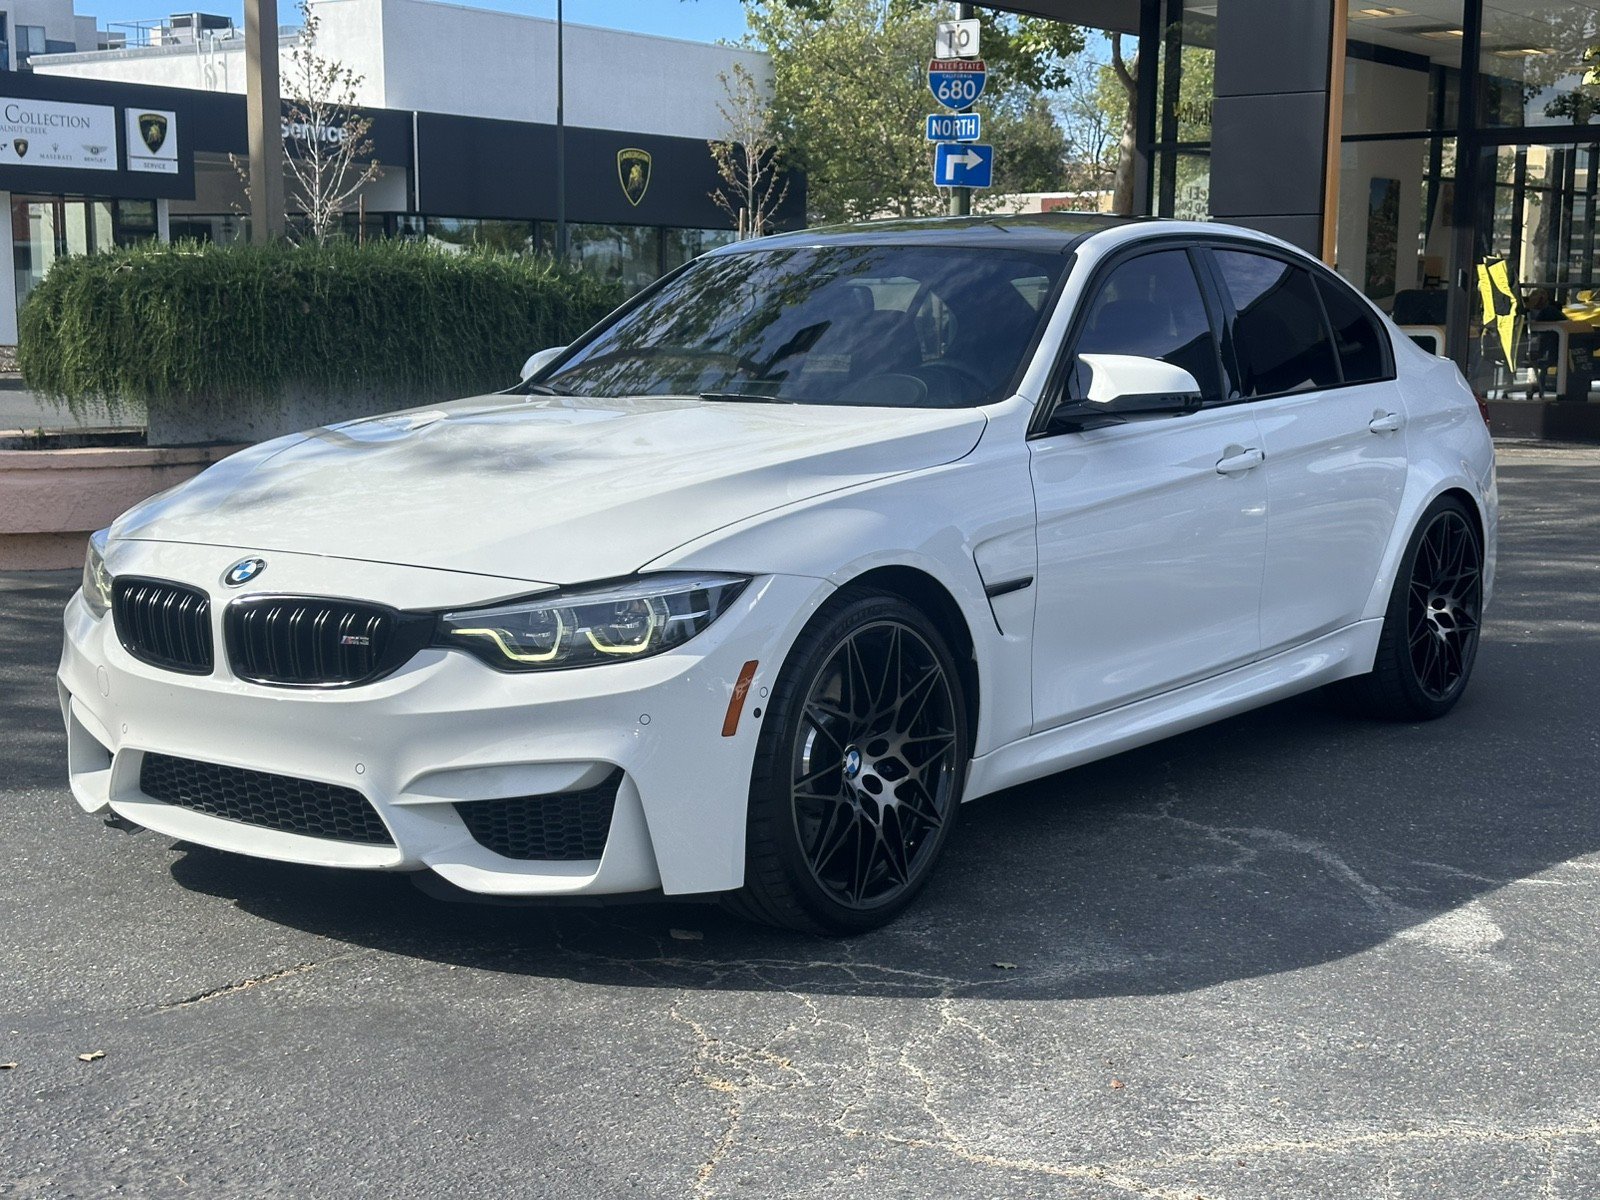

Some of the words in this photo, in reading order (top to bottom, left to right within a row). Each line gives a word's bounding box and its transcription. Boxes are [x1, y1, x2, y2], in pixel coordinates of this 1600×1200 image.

[947, 29, 970, 48] TO
[934, 62, 981, 70] INTERSTATE
[938, 80, 976, 99] 680
[281, 121, 348, 142] Service
[932, 119, 975, 135] NORTH
[143, 162, 166, 170] SERVICE
